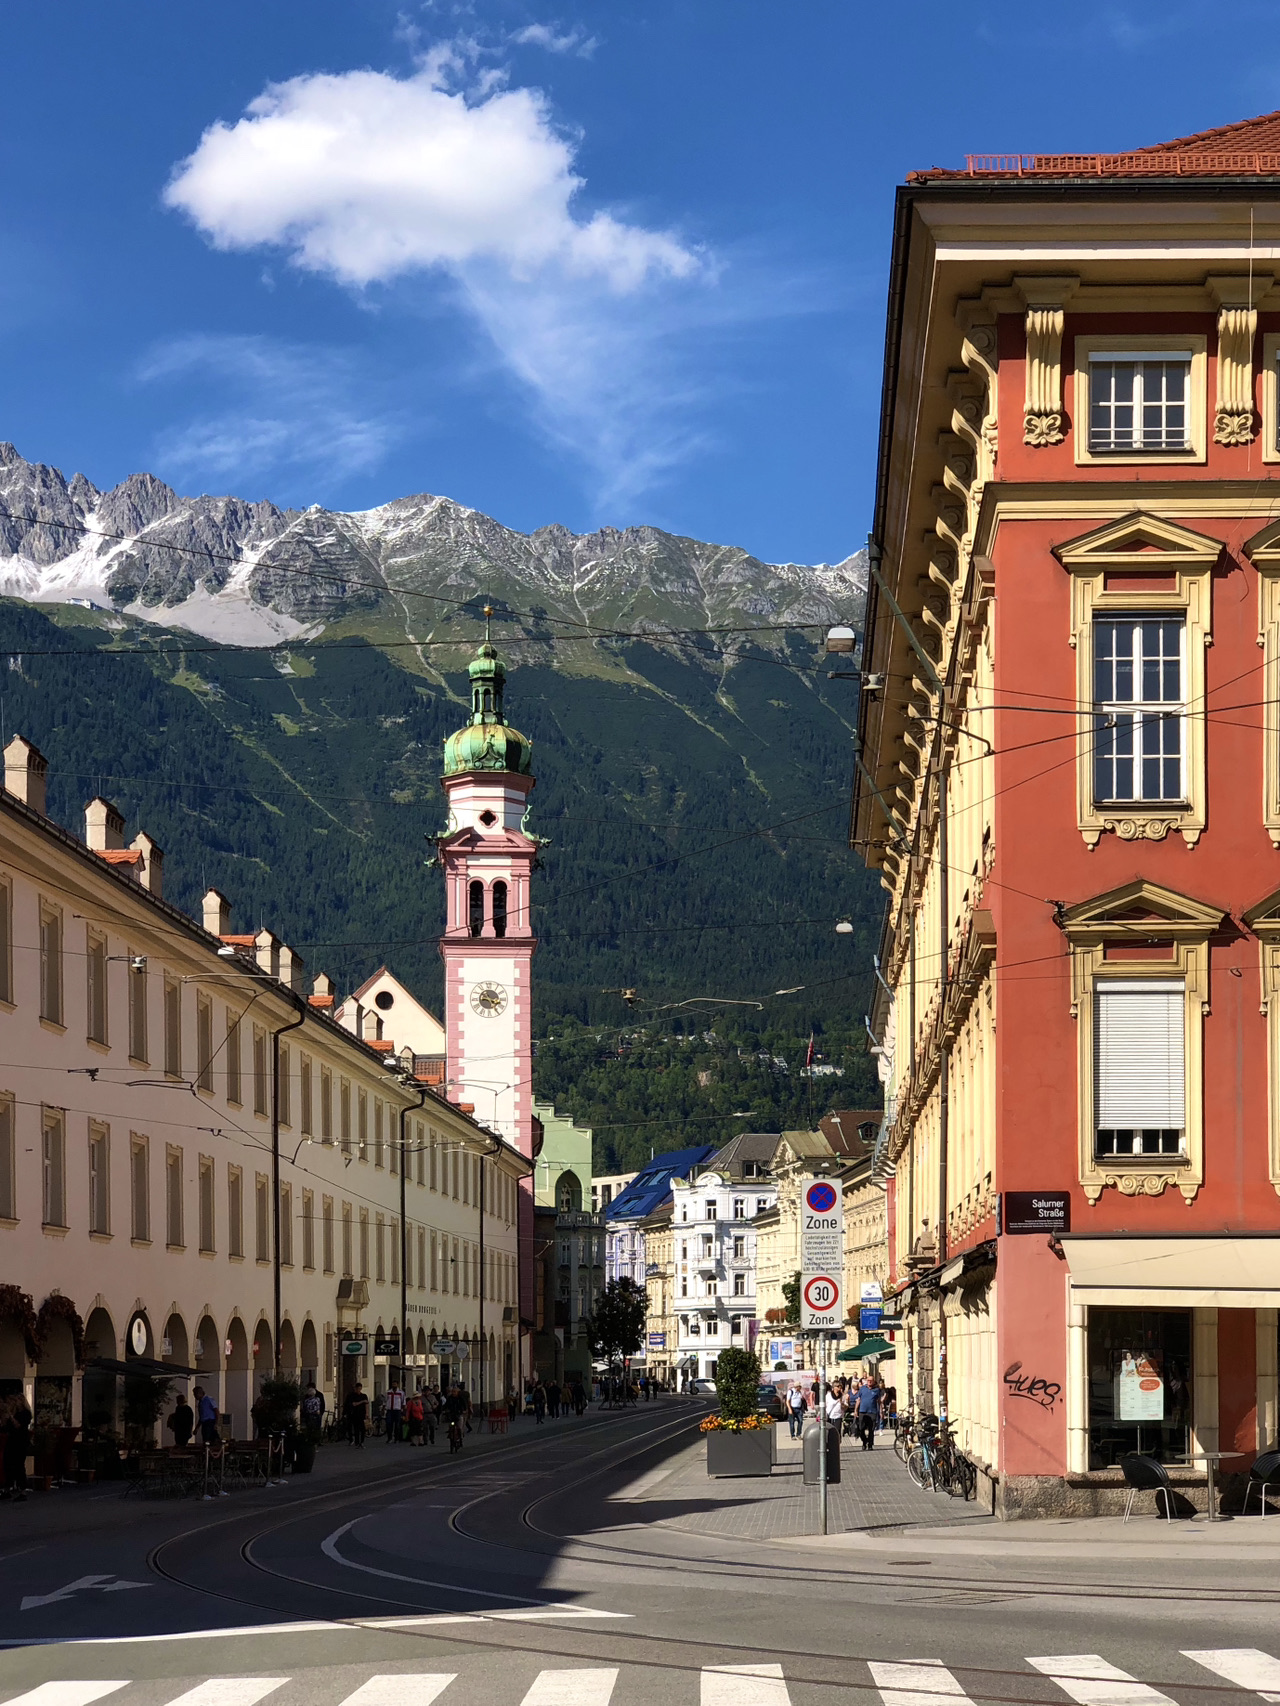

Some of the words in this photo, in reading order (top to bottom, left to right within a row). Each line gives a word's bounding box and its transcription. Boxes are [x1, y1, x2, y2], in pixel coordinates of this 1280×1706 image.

[1032, 1199, 1064, 1208] Salurner
[1038, 1208, 1064, 1218] Straße
[806, 1215, 837, 1229] Zone
[814, 1286, 829, 1302] 30
[808, 1313, 835, 1325] Zone
